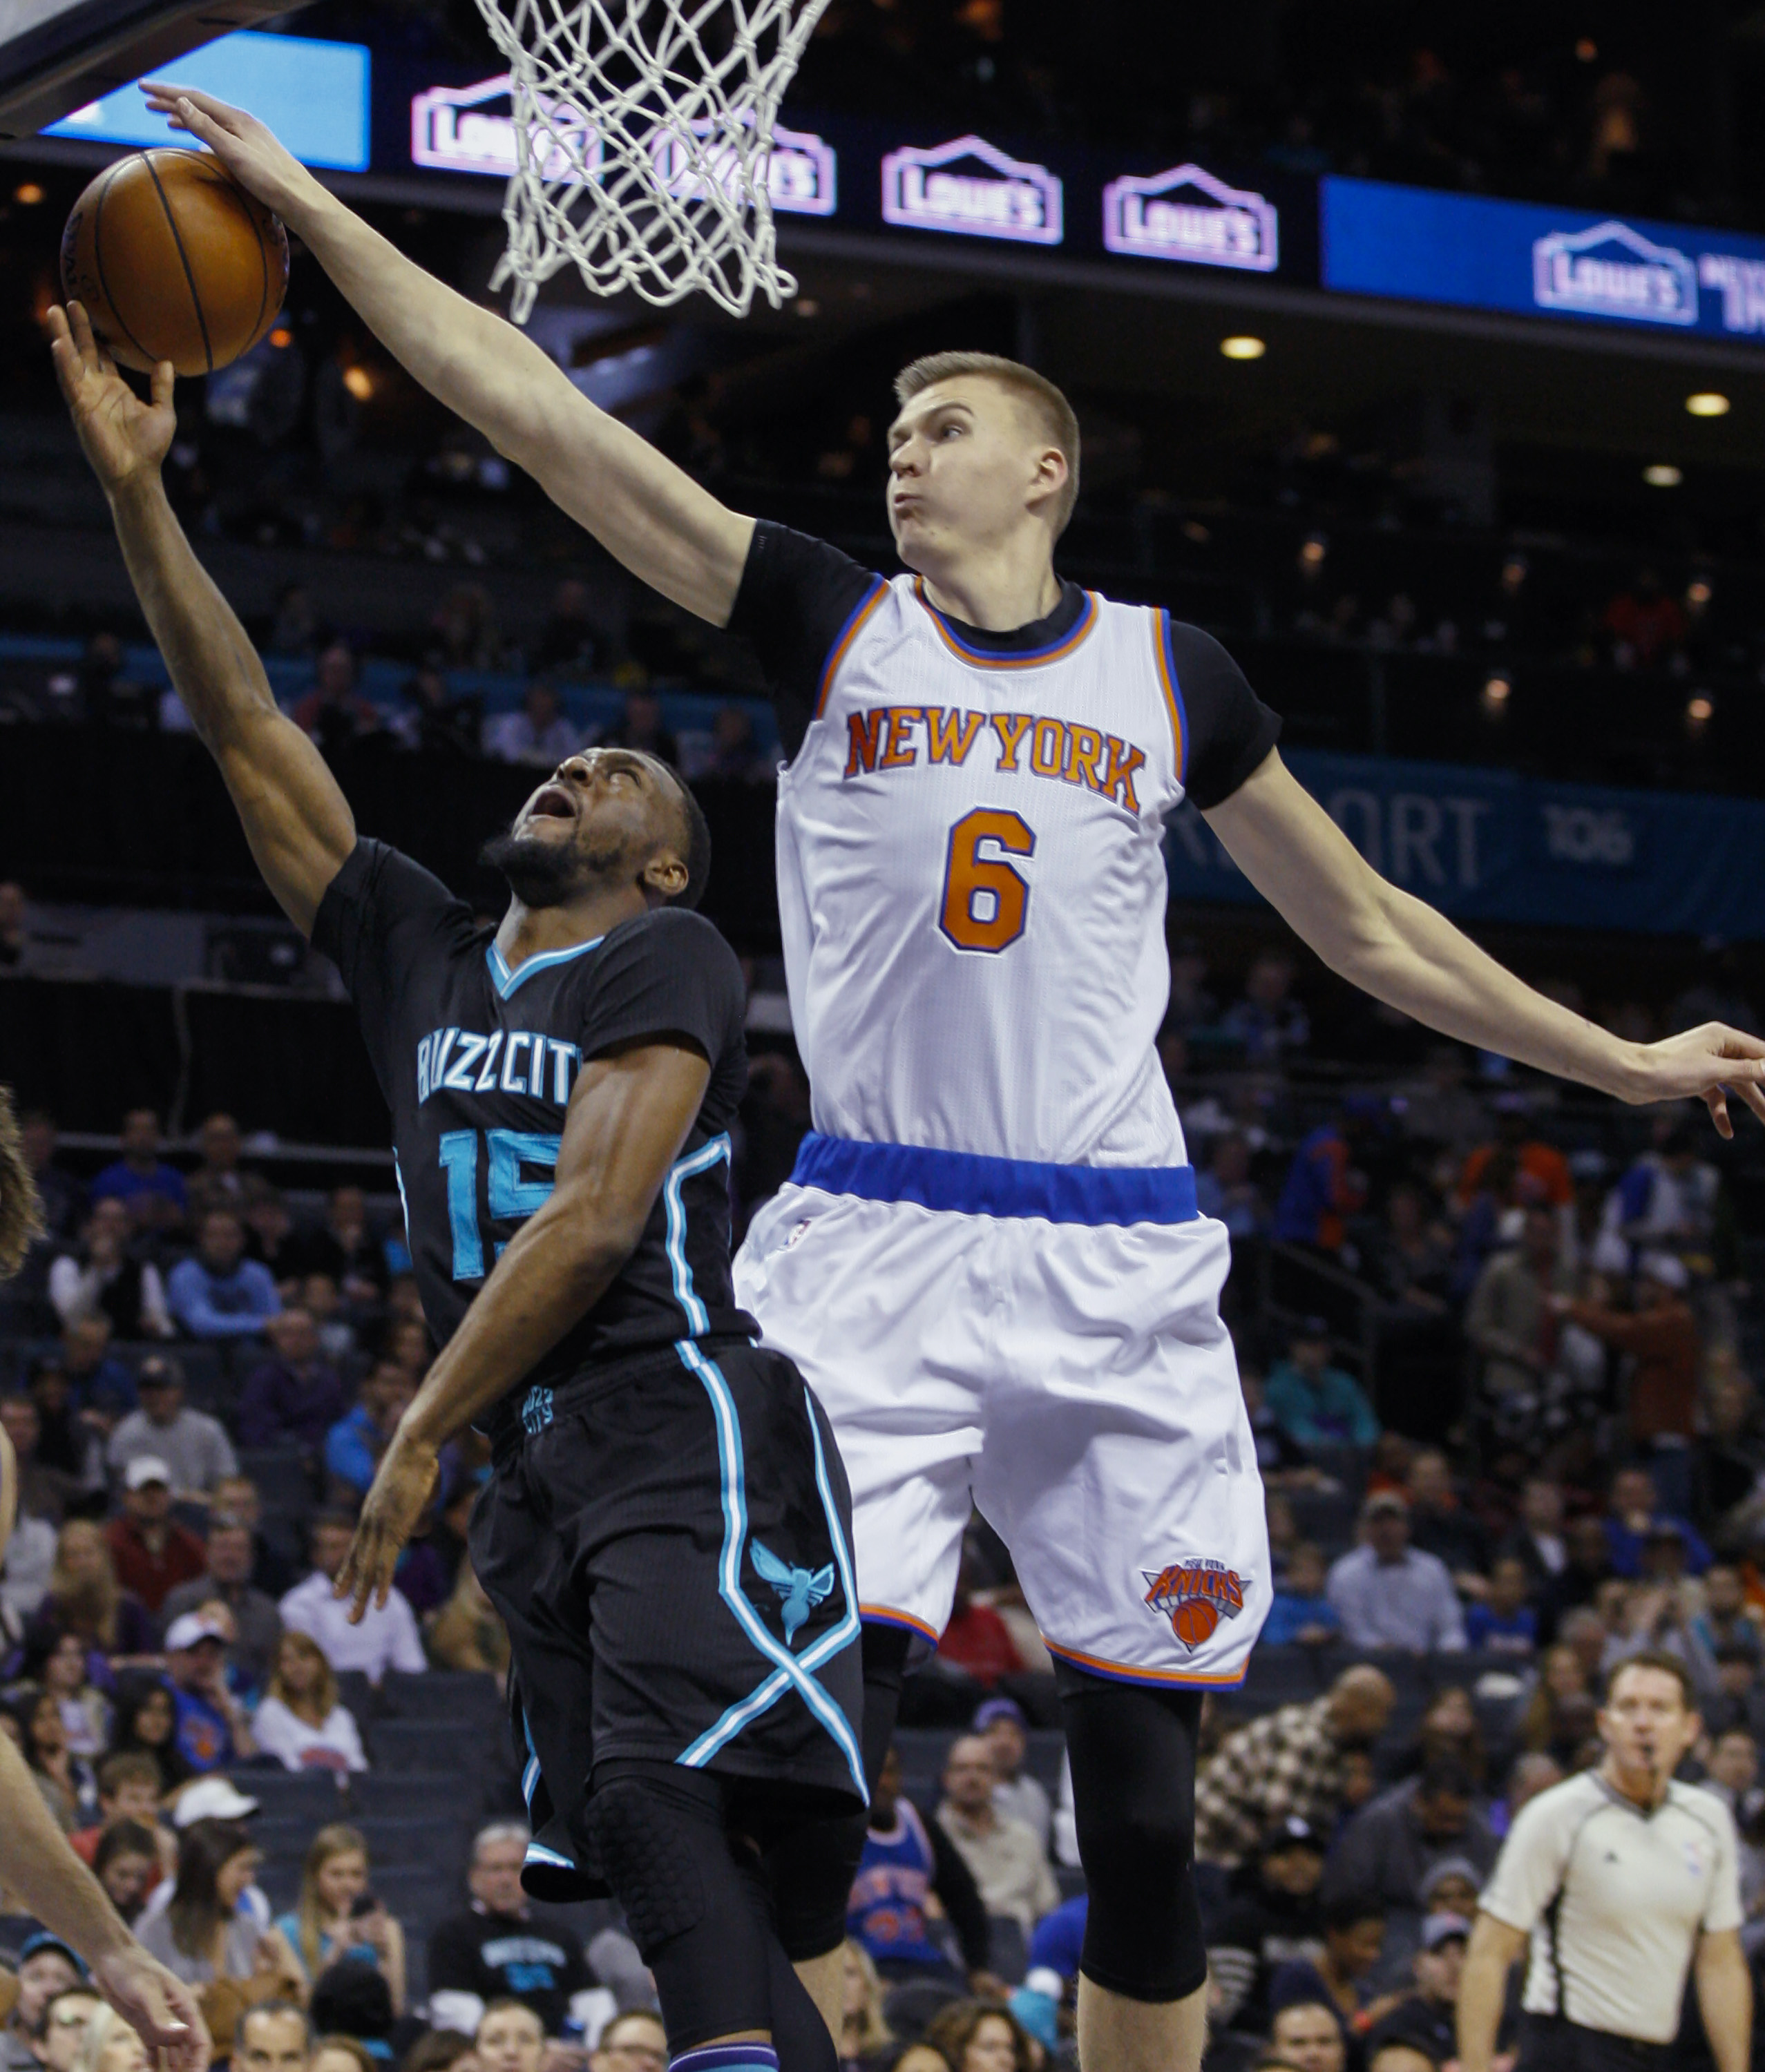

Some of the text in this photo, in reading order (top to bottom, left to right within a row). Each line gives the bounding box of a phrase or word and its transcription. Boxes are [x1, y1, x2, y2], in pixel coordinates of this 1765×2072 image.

[843, 706, 1147, 816] NEW YORK
[938, 805, 1037, 954] 6
[499, 1029, 584, 1106] CIT
[1144, 1562, 1245, 1613] KNICKS
